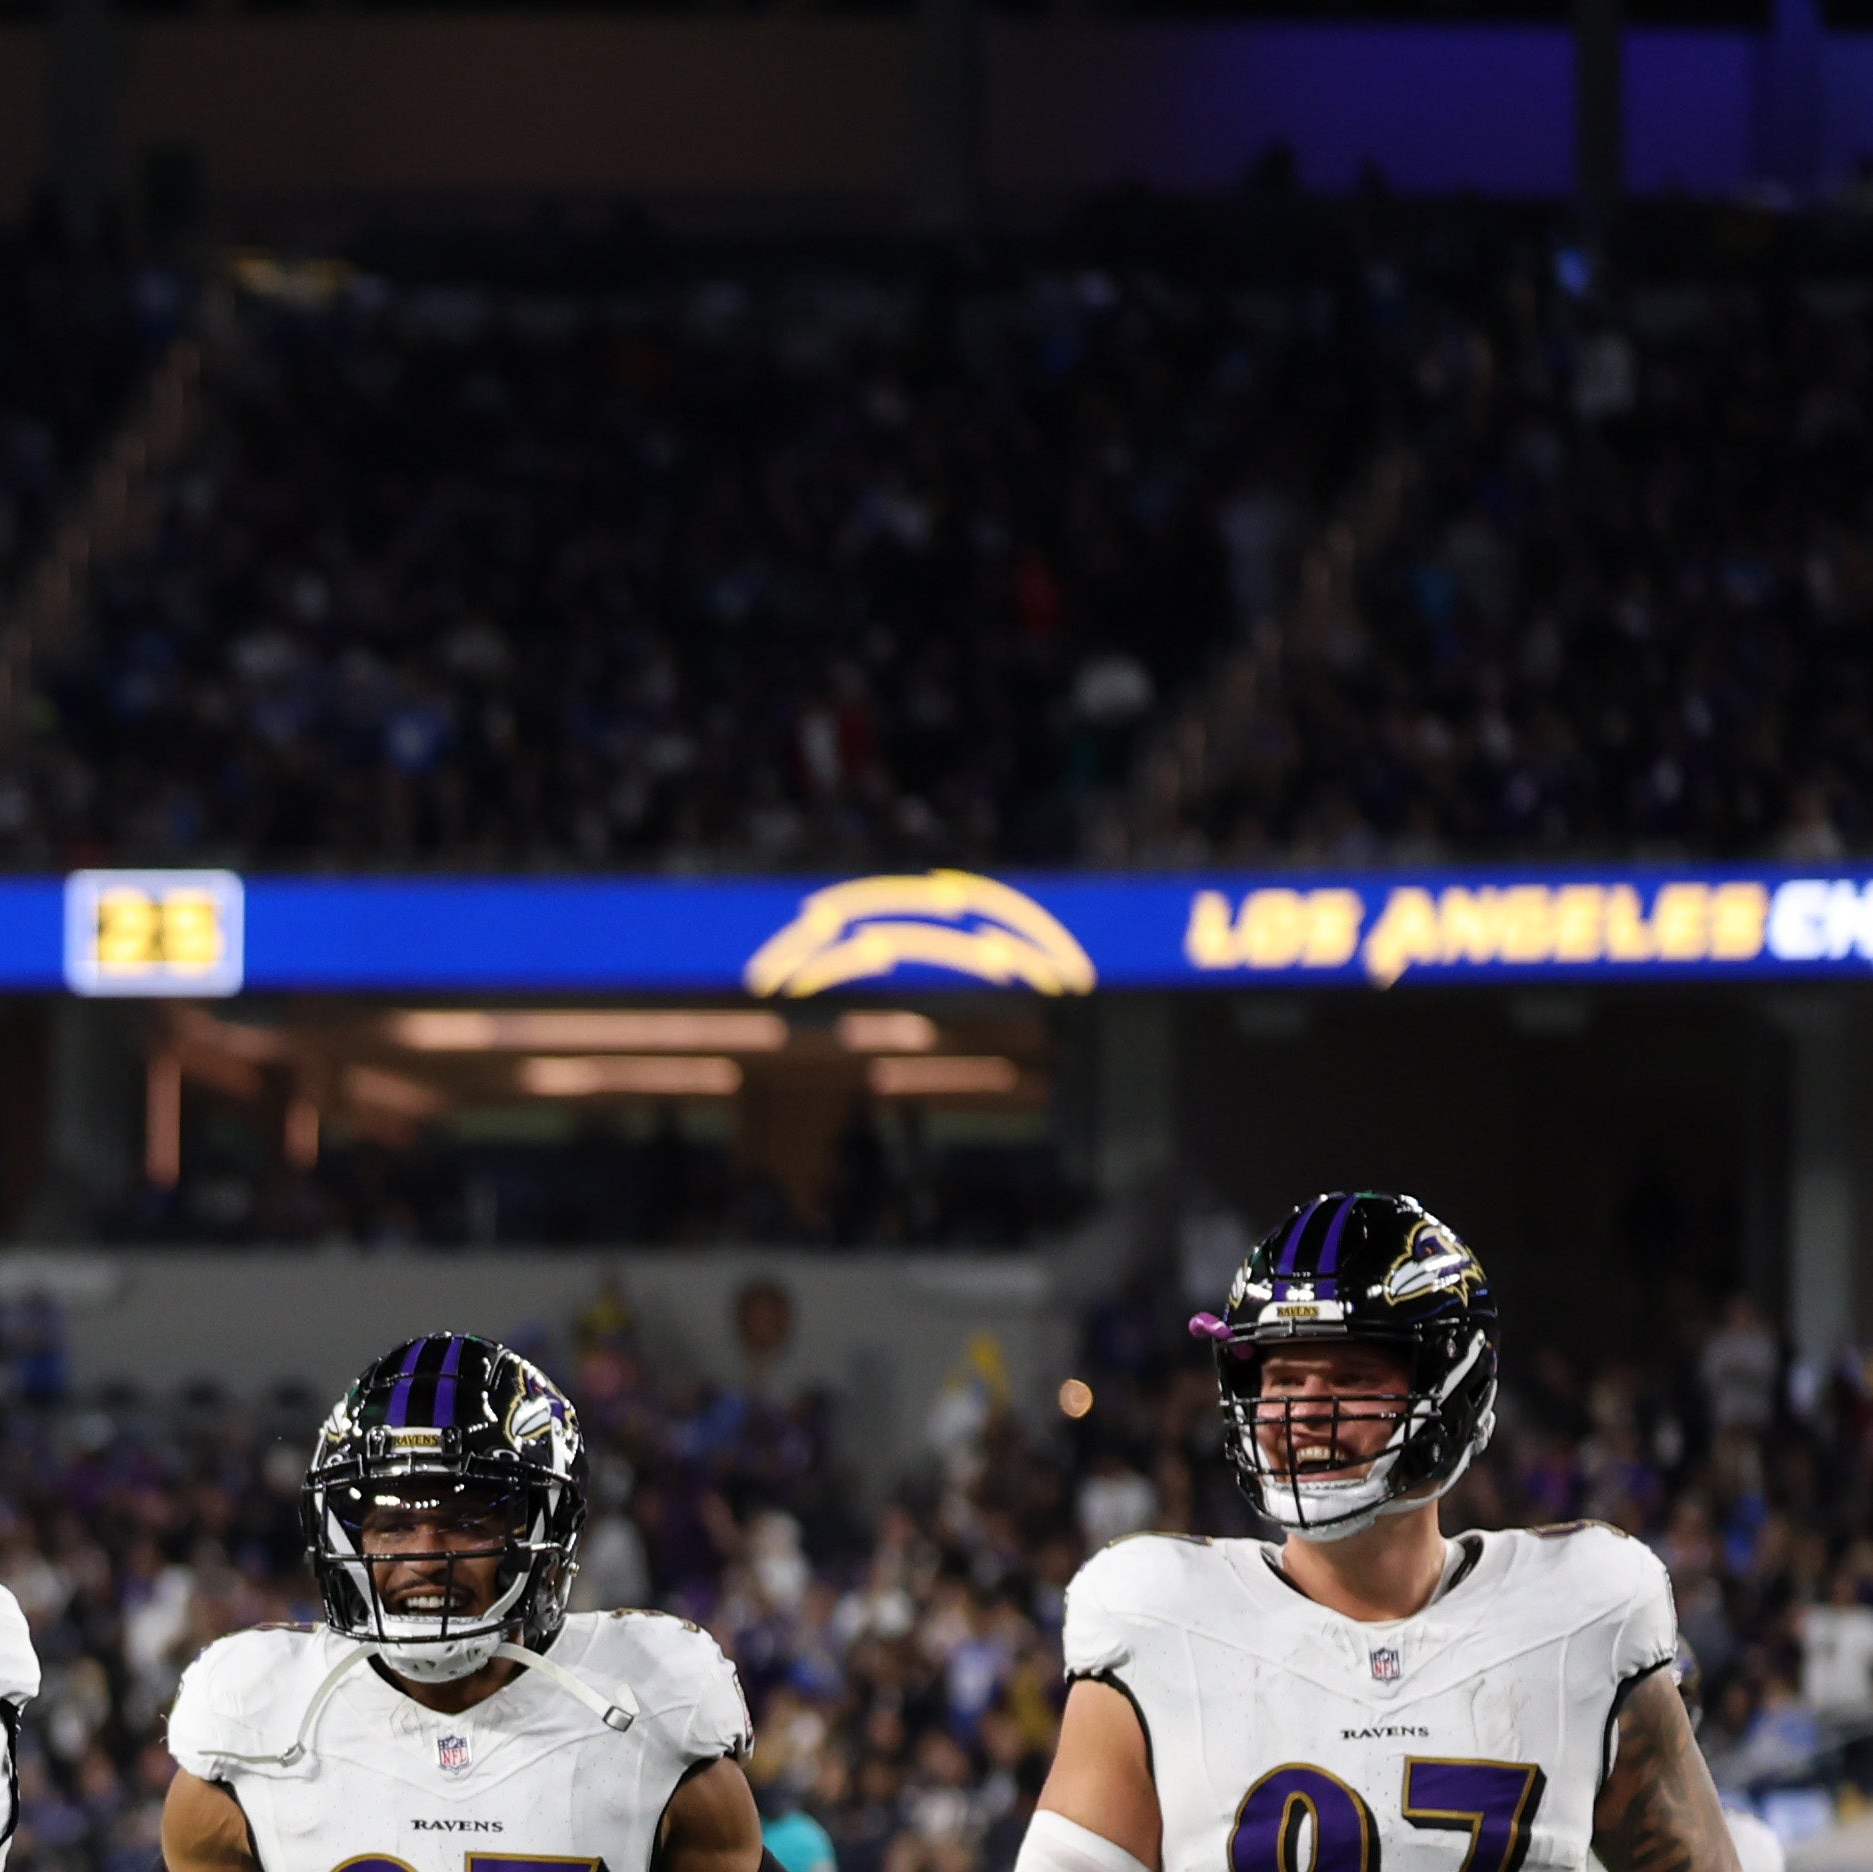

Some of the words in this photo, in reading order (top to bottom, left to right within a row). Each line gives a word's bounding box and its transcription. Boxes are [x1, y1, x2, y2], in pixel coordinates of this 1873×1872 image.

[1185, 886, 1363, 970] LOS
[1364, 881, 1768, 990] ANGELES
[394, 1434, 440, 1447] RAVENS
[1340, 1726, 1429, 1740] RAVENS
[411, 1819, 504, 1834] RAVENS
